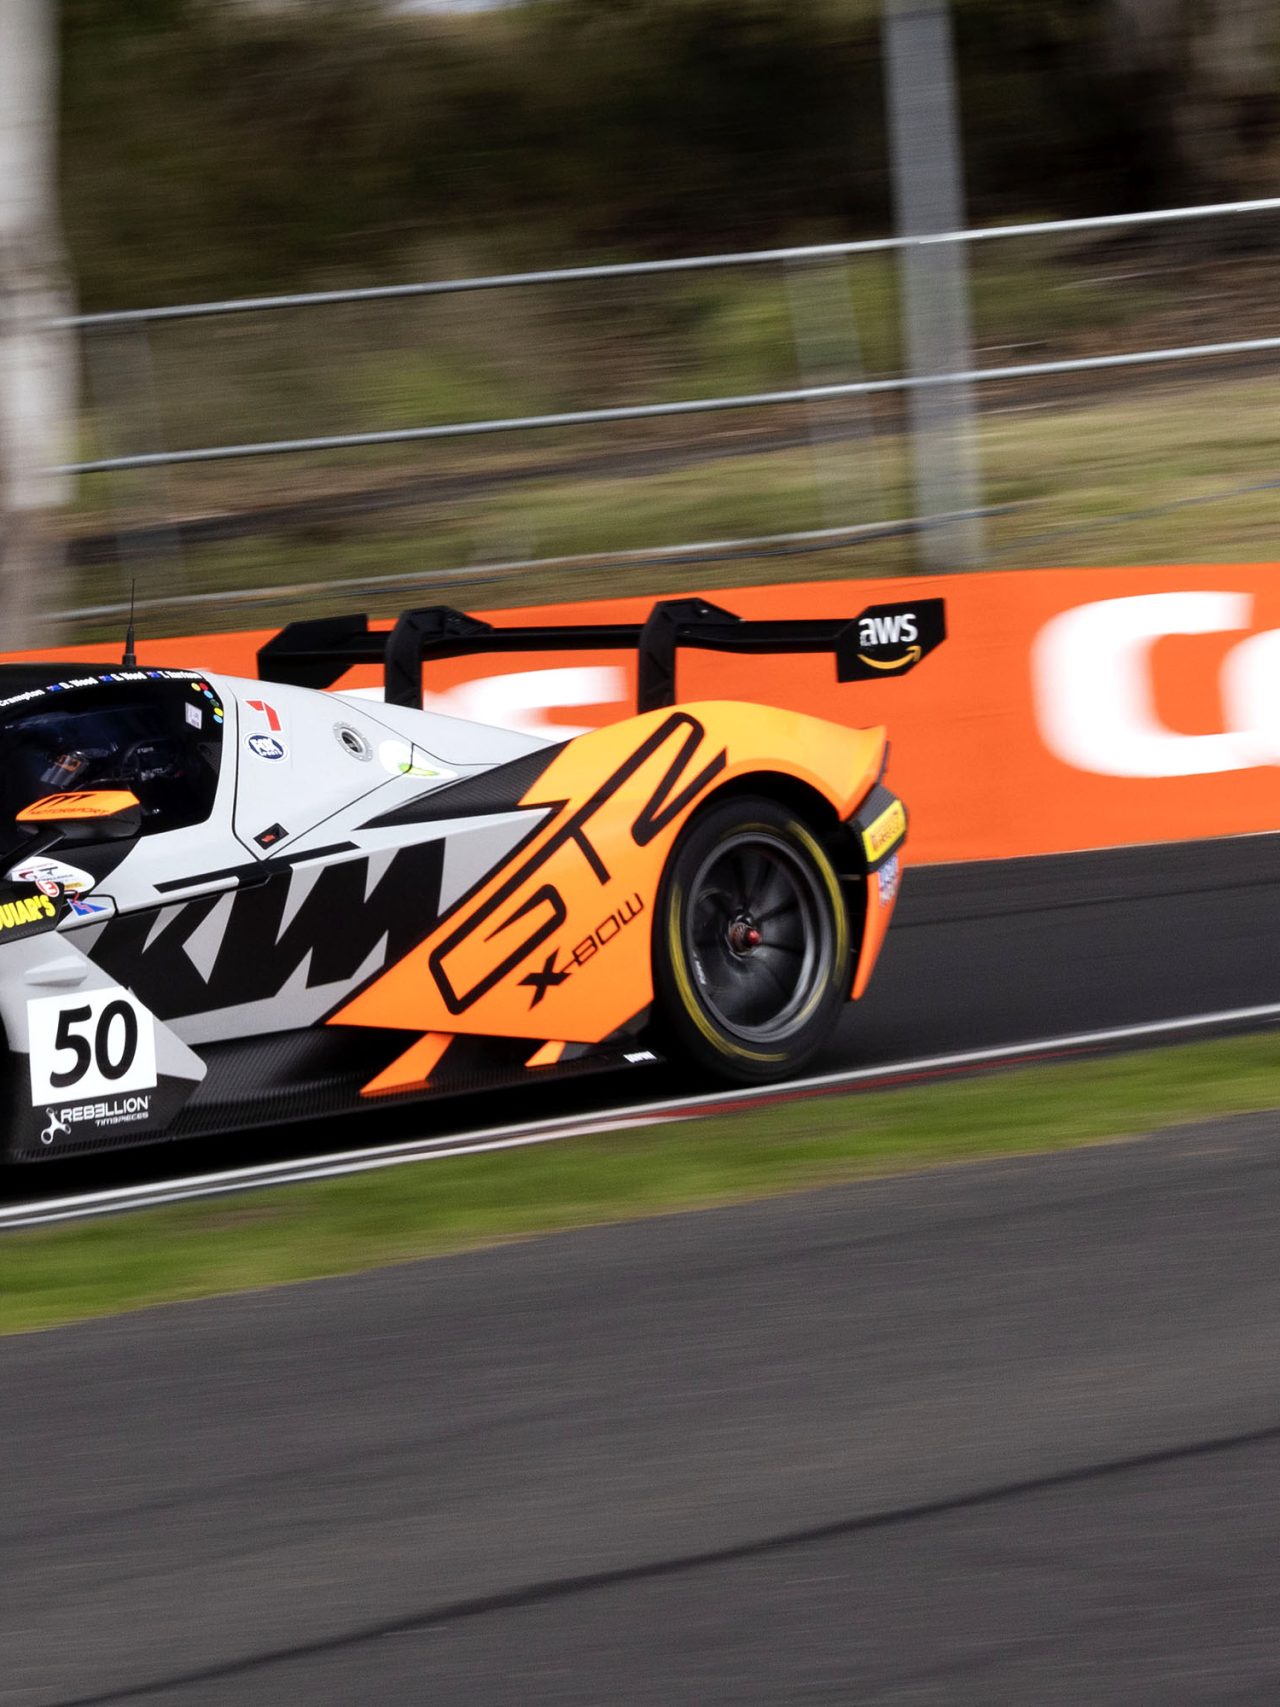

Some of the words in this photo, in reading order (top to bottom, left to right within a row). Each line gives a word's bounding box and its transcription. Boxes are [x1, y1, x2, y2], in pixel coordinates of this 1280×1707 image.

[858, 613, 918, 647] aws
[87, 836, 447, 1021] KTM
[516, 892, 645, 1012] X-BOW
[49, 999, 138, 1088] 50
[60, 1095, 148, 1123] REBELLION
